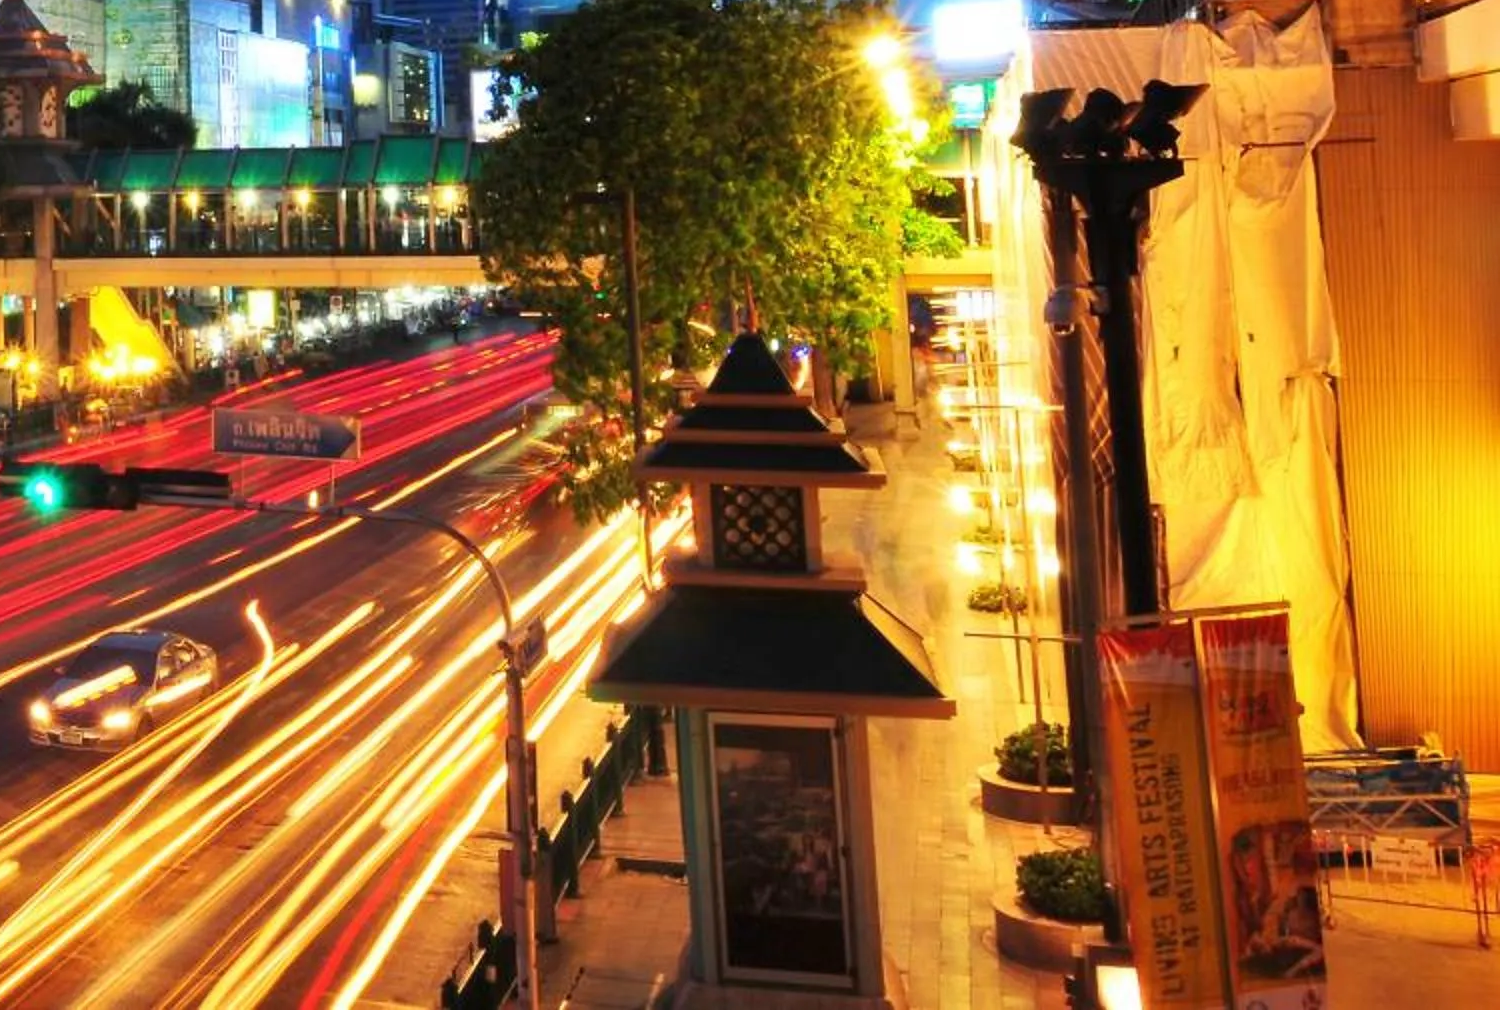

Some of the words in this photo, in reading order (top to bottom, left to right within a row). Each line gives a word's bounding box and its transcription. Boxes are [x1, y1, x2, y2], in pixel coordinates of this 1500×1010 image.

[1127, 702, 1162, 824] FESTIVAL
[1141, 833, 1169, 899] ARTS
[1182, 924, 1201, 949] AT
